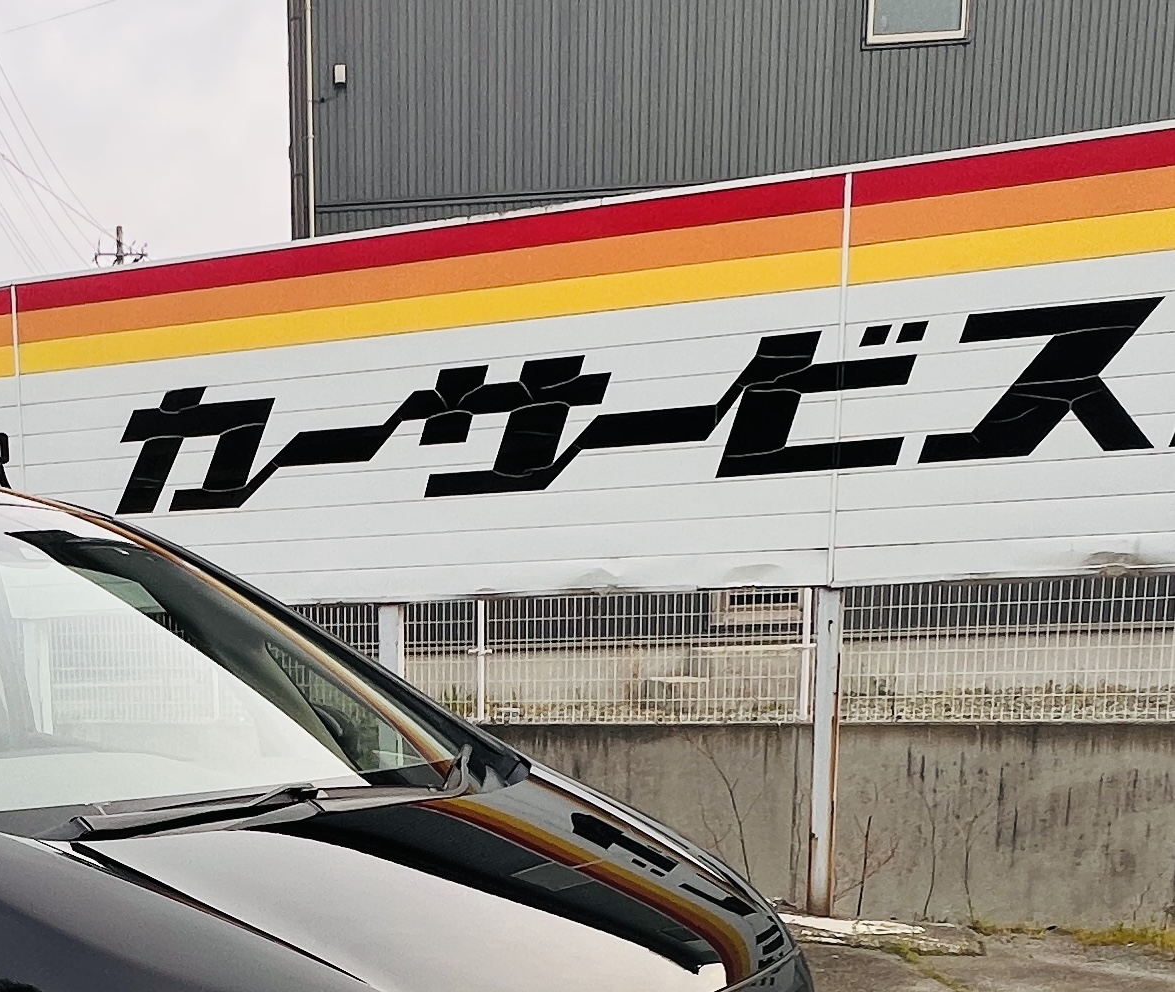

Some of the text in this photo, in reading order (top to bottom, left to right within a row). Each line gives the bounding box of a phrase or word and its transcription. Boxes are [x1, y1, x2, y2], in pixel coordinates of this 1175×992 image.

[115, 296, 1175, 514] カーサービス
